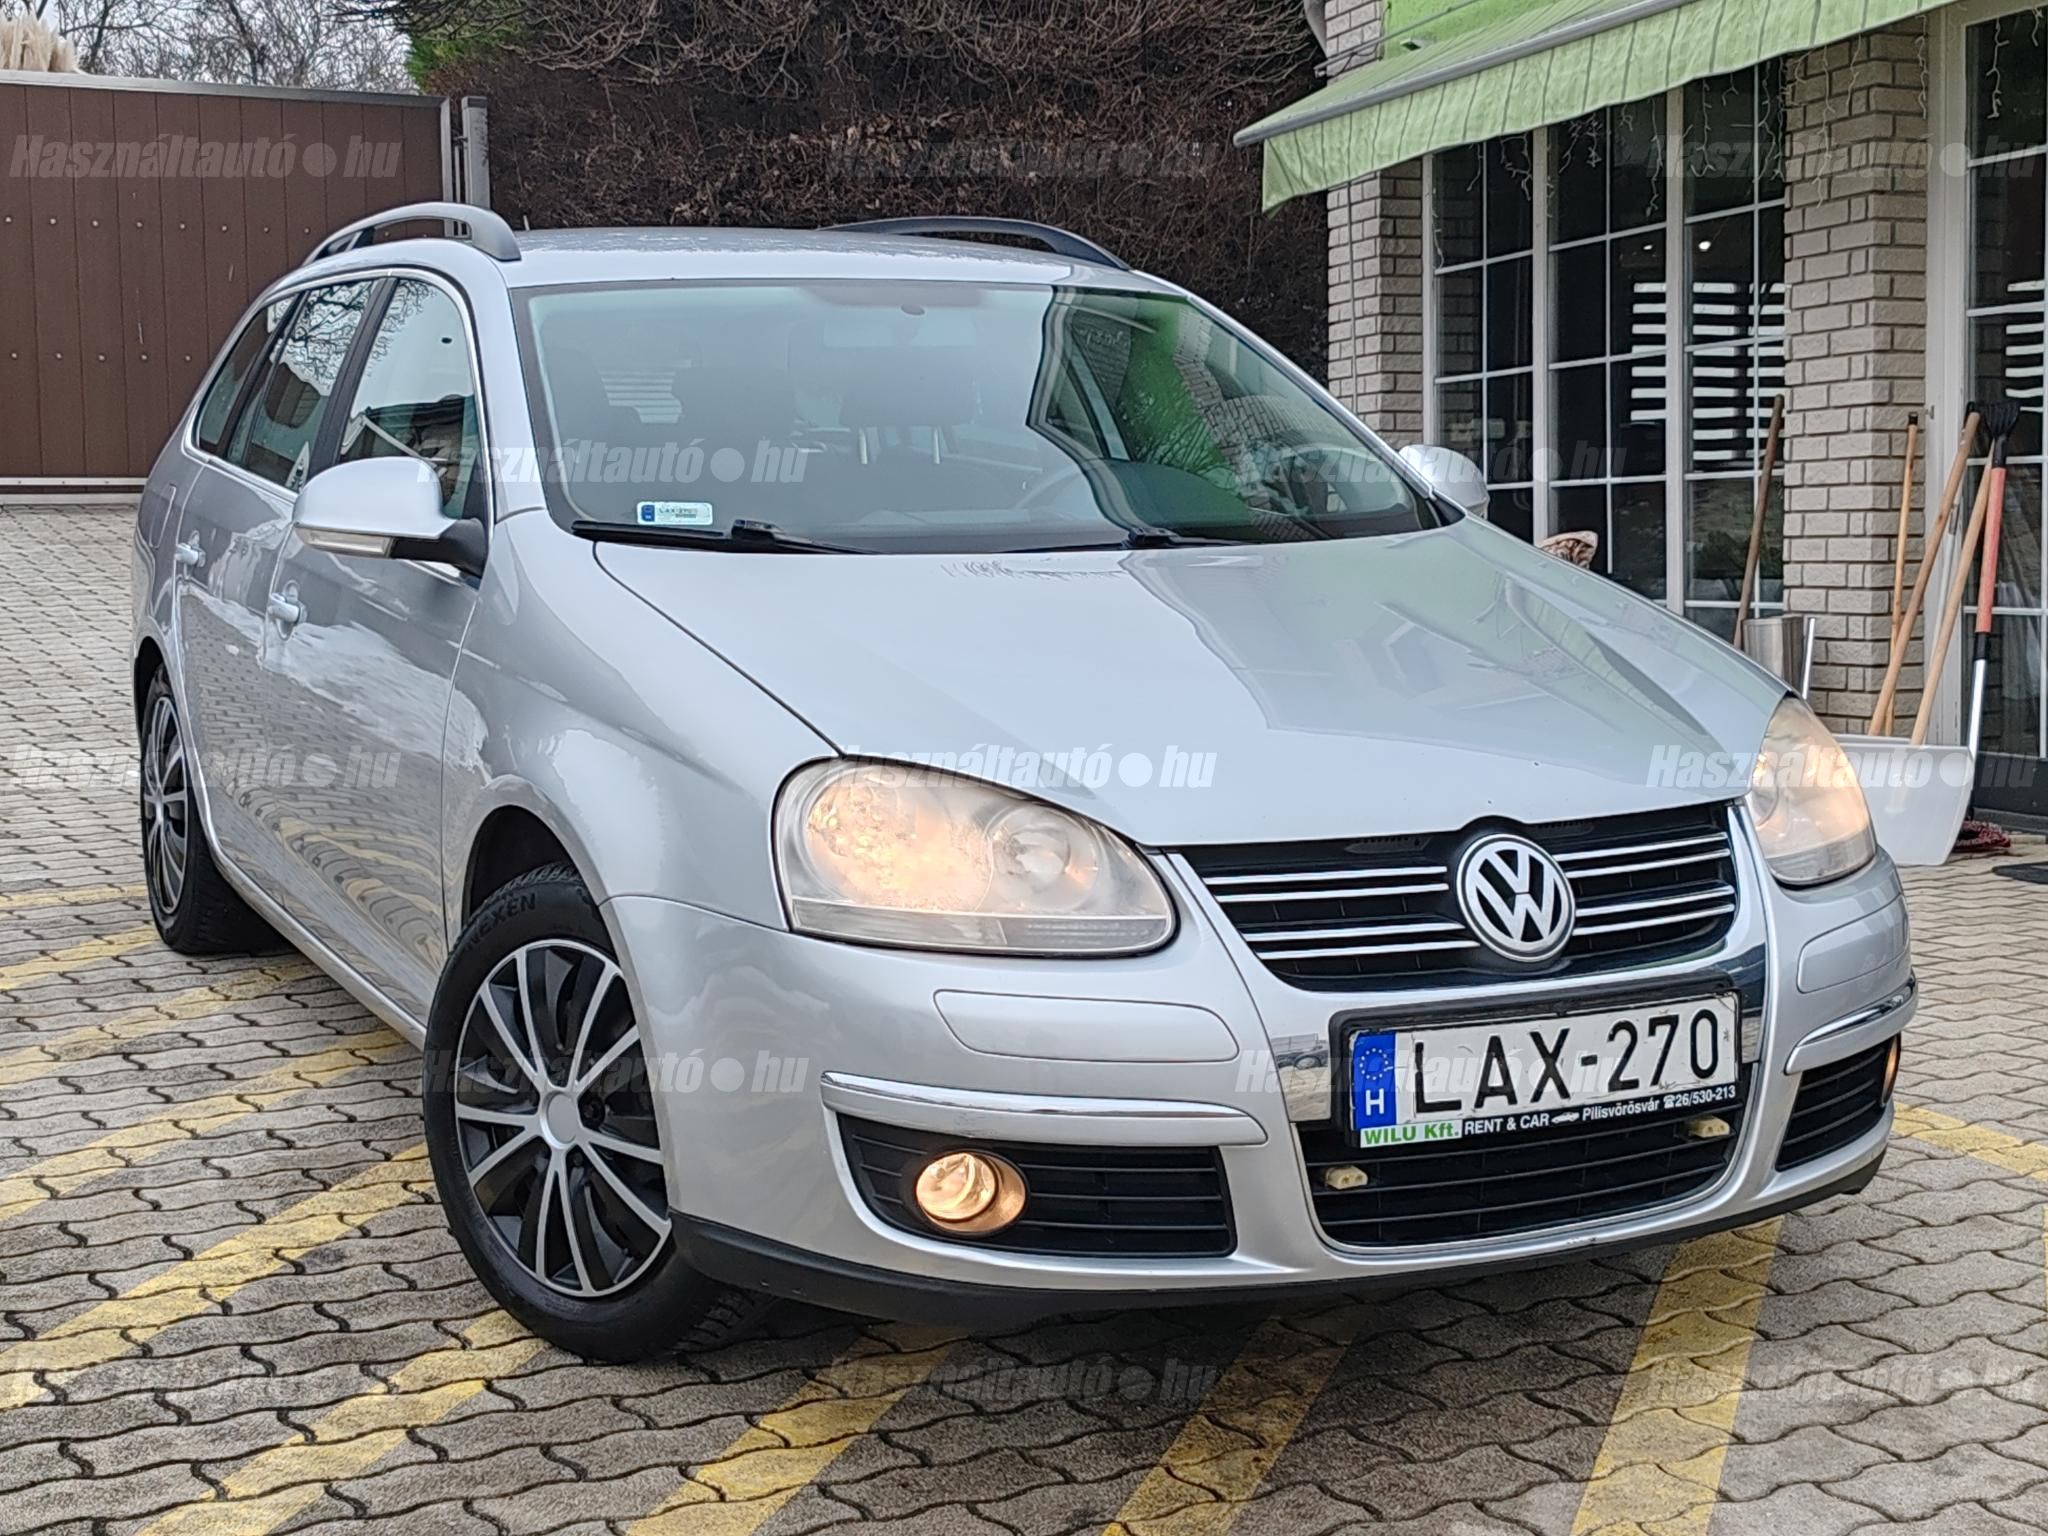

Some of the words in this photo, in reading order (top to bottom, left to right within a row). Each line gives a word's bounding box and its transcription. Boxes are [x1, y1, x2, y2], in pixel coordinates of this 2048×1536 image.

[464, 892, 536, 952] NEXEN
[1413, 1008, 1719, 1114] LAX-270
[1363, 1126, 1417, 1145] WILU
[1424, 1122, 1460, 1140] Kft.
[1464, 1118, 1503, 1136] RENT
[1506, 1118, 1517, 1131] &
[1519, 1113, 1550, 1129] CAR
[1582, 1097, 1660, 1122] Pilisvörösvár
[1365, 1088, 1385, 1116] H
